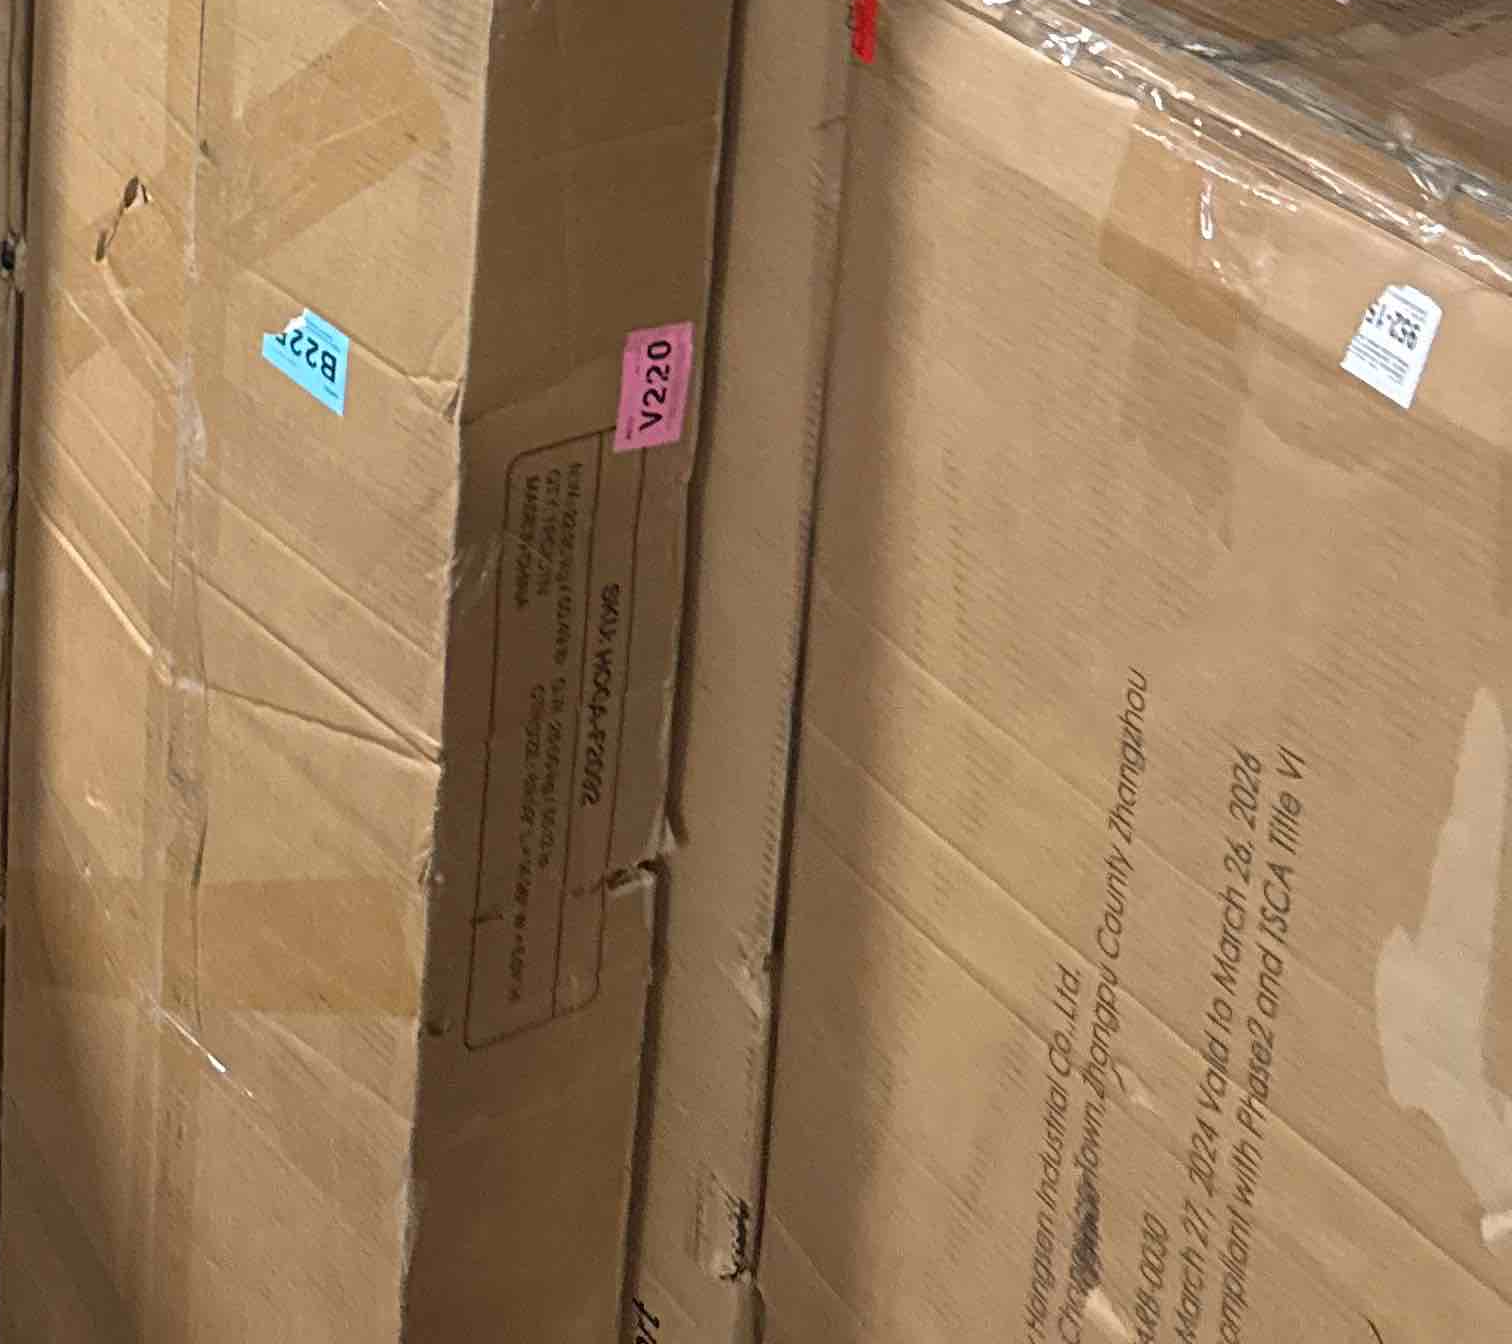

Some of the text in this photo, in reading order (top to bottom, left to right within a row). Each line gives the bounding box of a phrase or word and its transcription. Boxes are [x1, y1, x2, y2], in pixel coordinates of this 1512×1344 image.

[639, 340, 672, 431] V220
[1108, 665, 1148, 845] Zhangzhou
[1230, 744, 1262, 831] 2026
[1096, 843, 1134, 960] County
[1211, 885, 1247, 997] March
[1205, 997, 1233, 1034] to
[1233, 1127, 1264, 1204] with
[1256, 948, 1285, 1017] and
[1276, 744, 1306, 779] VI
[1198, 1029, 1229, 1113] Valid
[1035, 1072, 1069, 1210] Industrial
[1189, 1116, 1219, 1197] 2024
